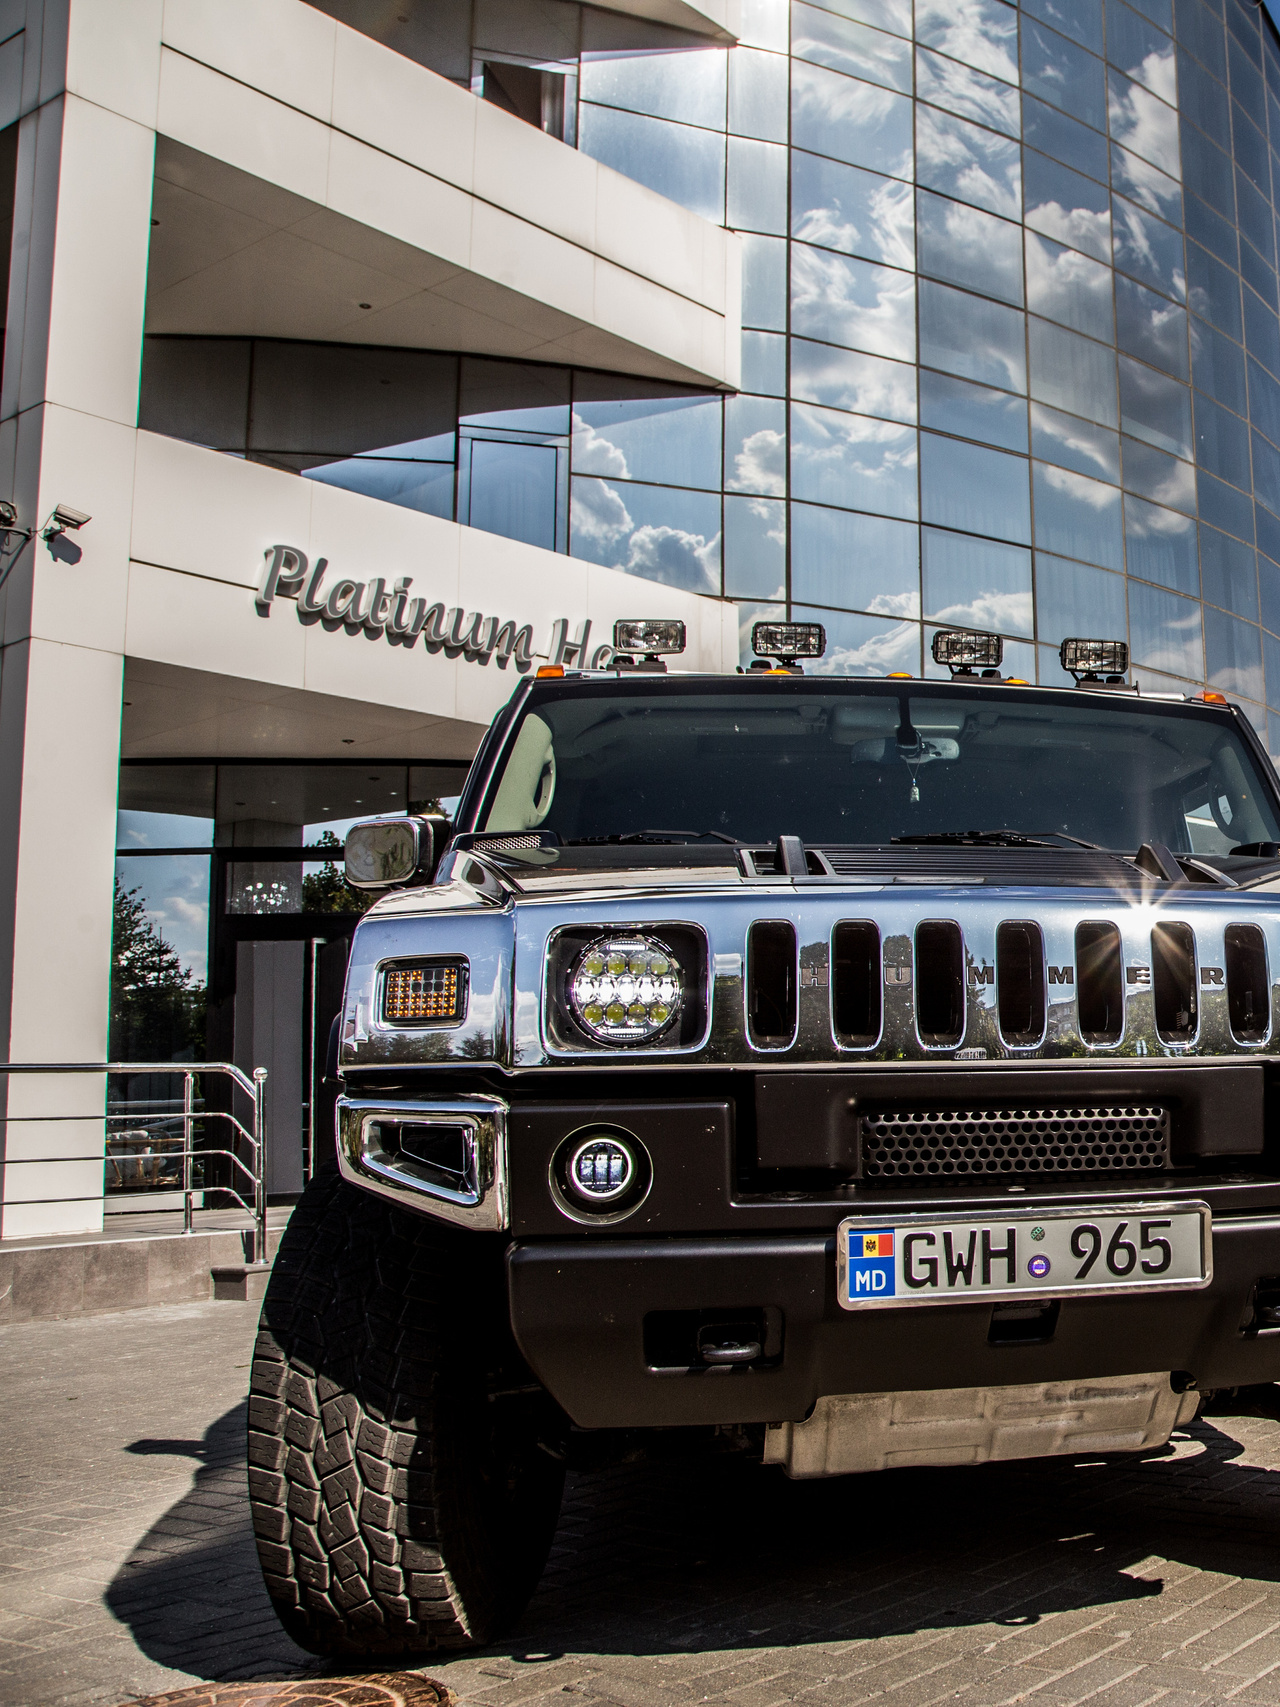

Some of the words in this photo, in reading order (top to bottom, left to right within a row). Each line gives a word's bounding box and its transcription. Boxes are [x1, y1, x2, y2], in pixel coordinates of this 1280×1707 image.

[256, 544, 538, 667] Platinum
[550, 618, 618, 669] Ha
[800, 965, 1225, 987] HUMMER
[902, 1227, 1016, 1288] GWH
[1070, 1219, 1172, 1281] 965
[855, 1269, 887, 1292] MD
